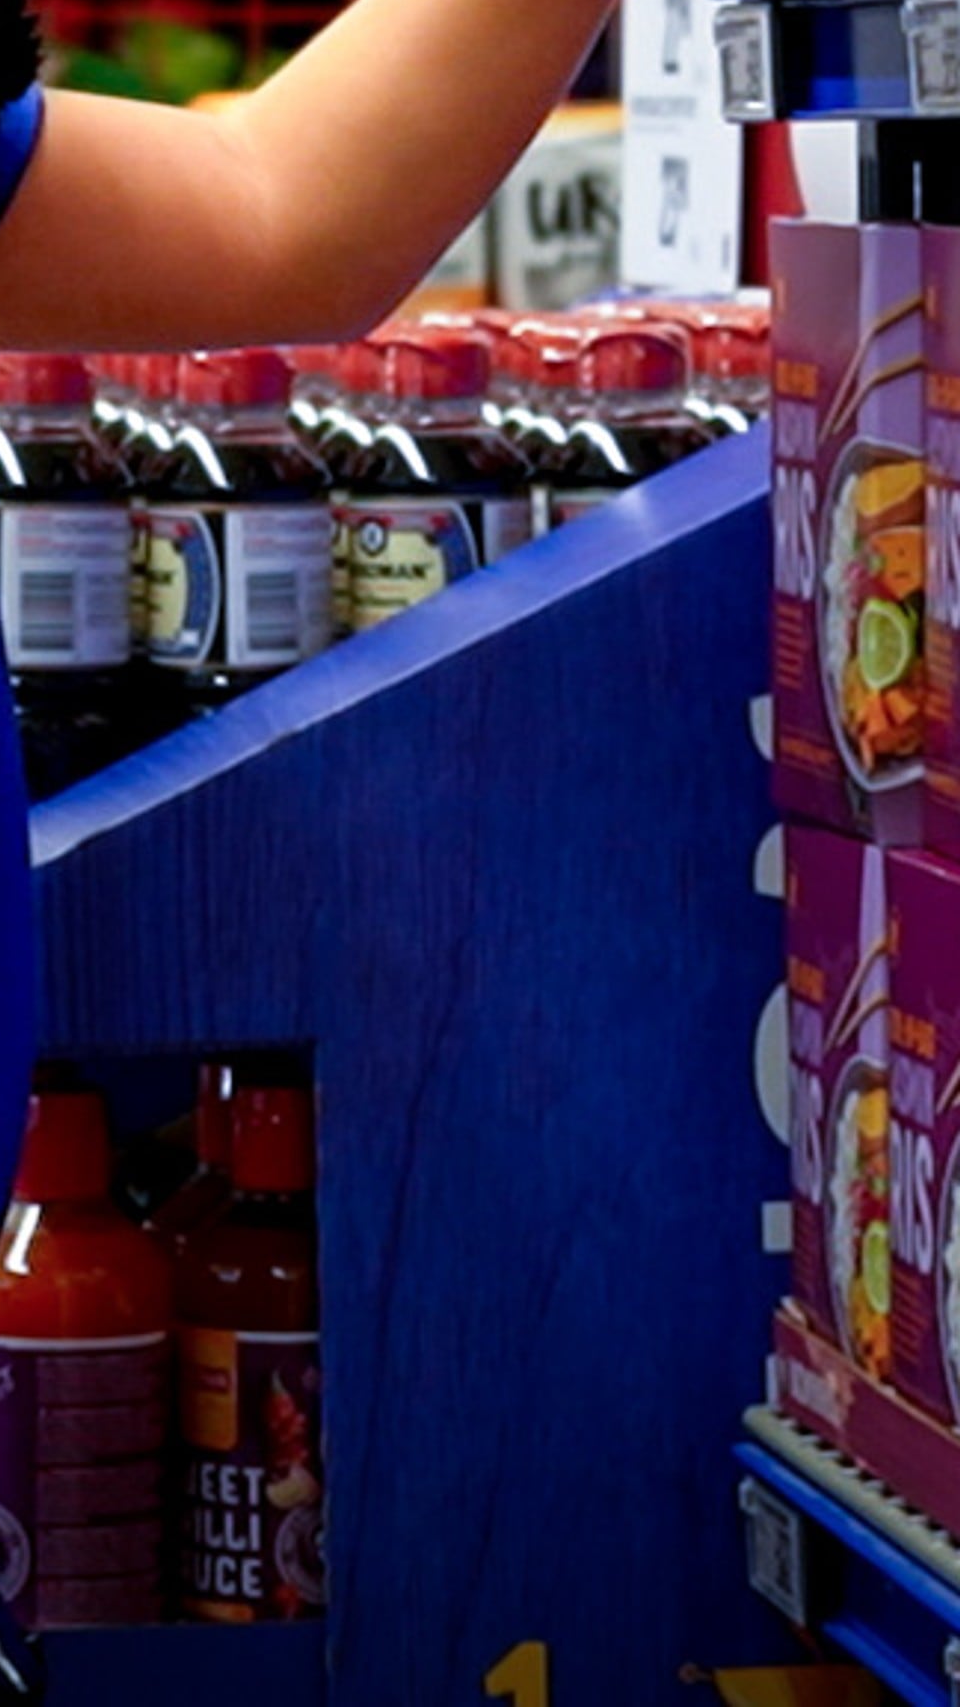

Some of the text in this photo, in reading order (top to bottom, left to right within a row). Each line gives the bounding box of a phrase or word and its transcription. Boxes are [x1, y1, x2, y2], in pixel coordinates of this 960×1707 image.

[190, 1462, 266, 1508] EET
[194, 1507, 262, 1553] ILLI
[194, 1553, 265, 1600] UCE
